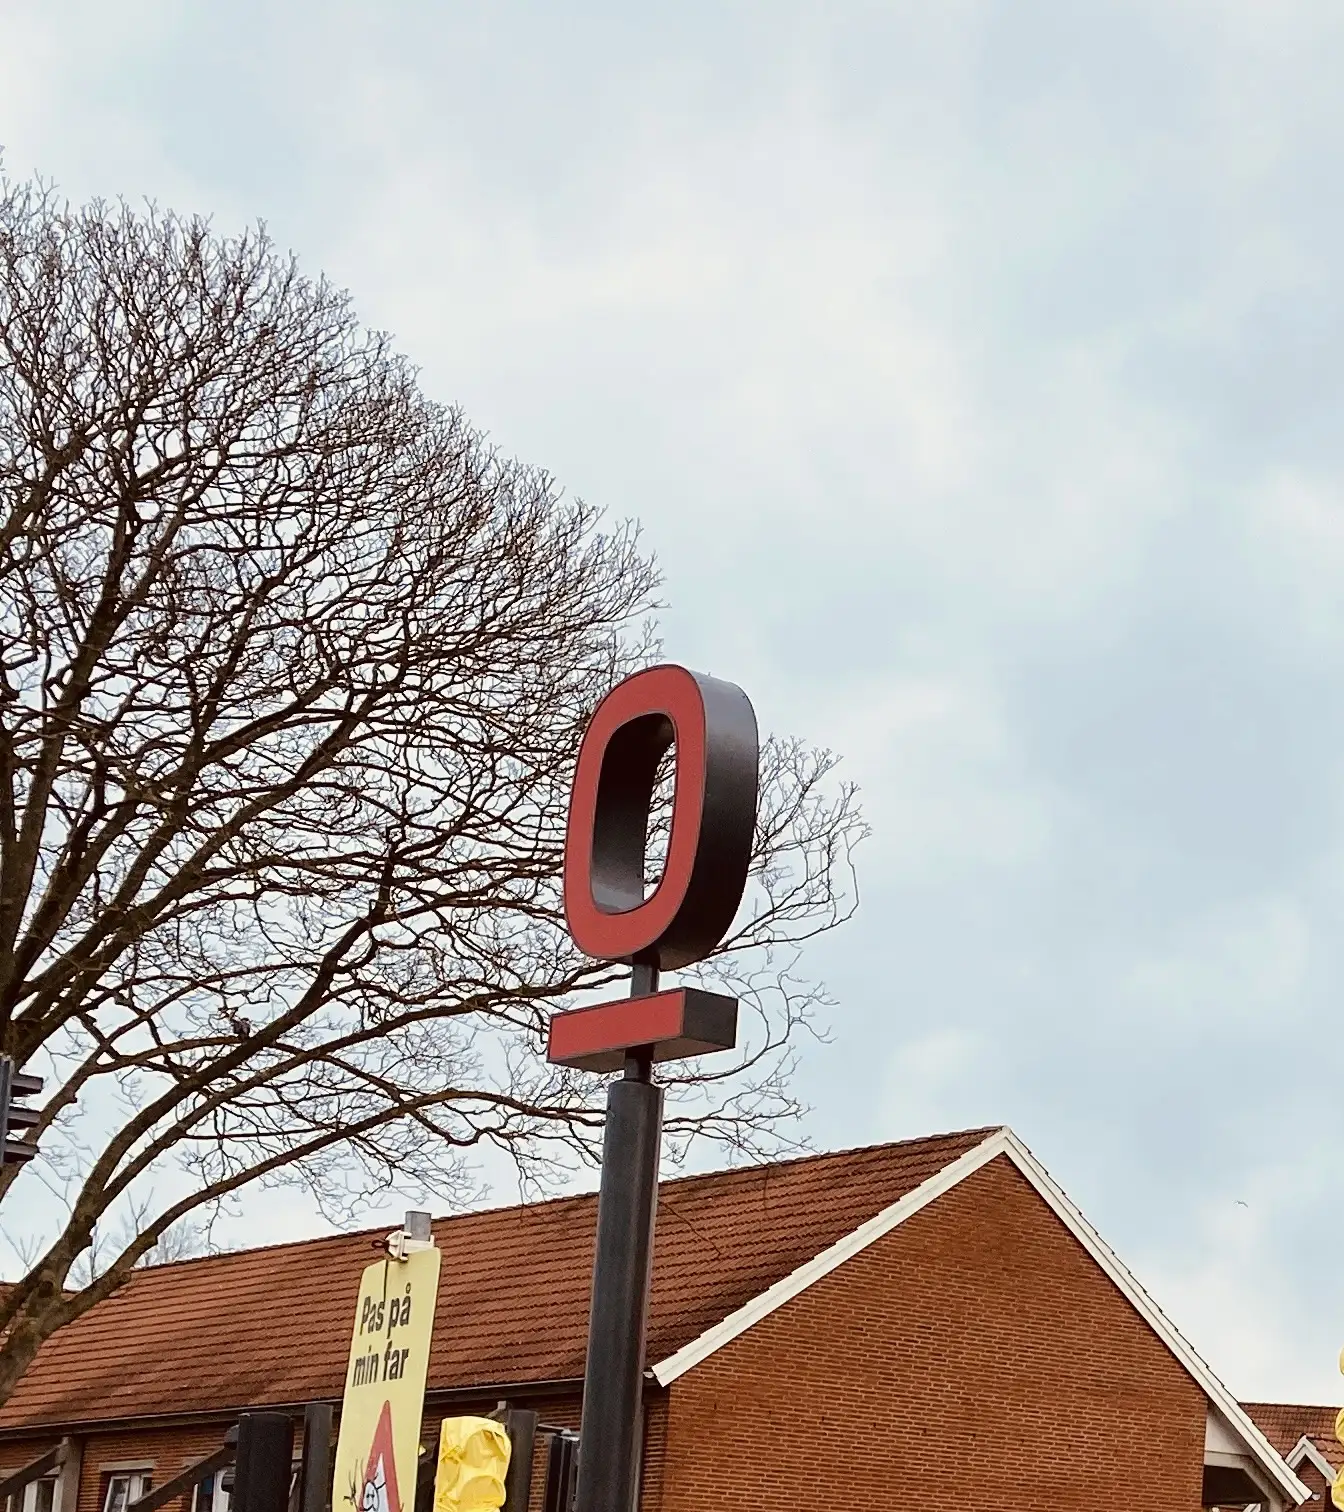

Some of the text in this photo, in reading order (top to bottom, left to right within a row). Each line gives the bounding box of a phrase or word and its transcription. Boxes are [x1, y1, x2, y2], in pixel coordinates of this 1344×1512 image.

[360, 1282, 412, 1340] Pas på
[352, 1340, 410, 1387] min far
